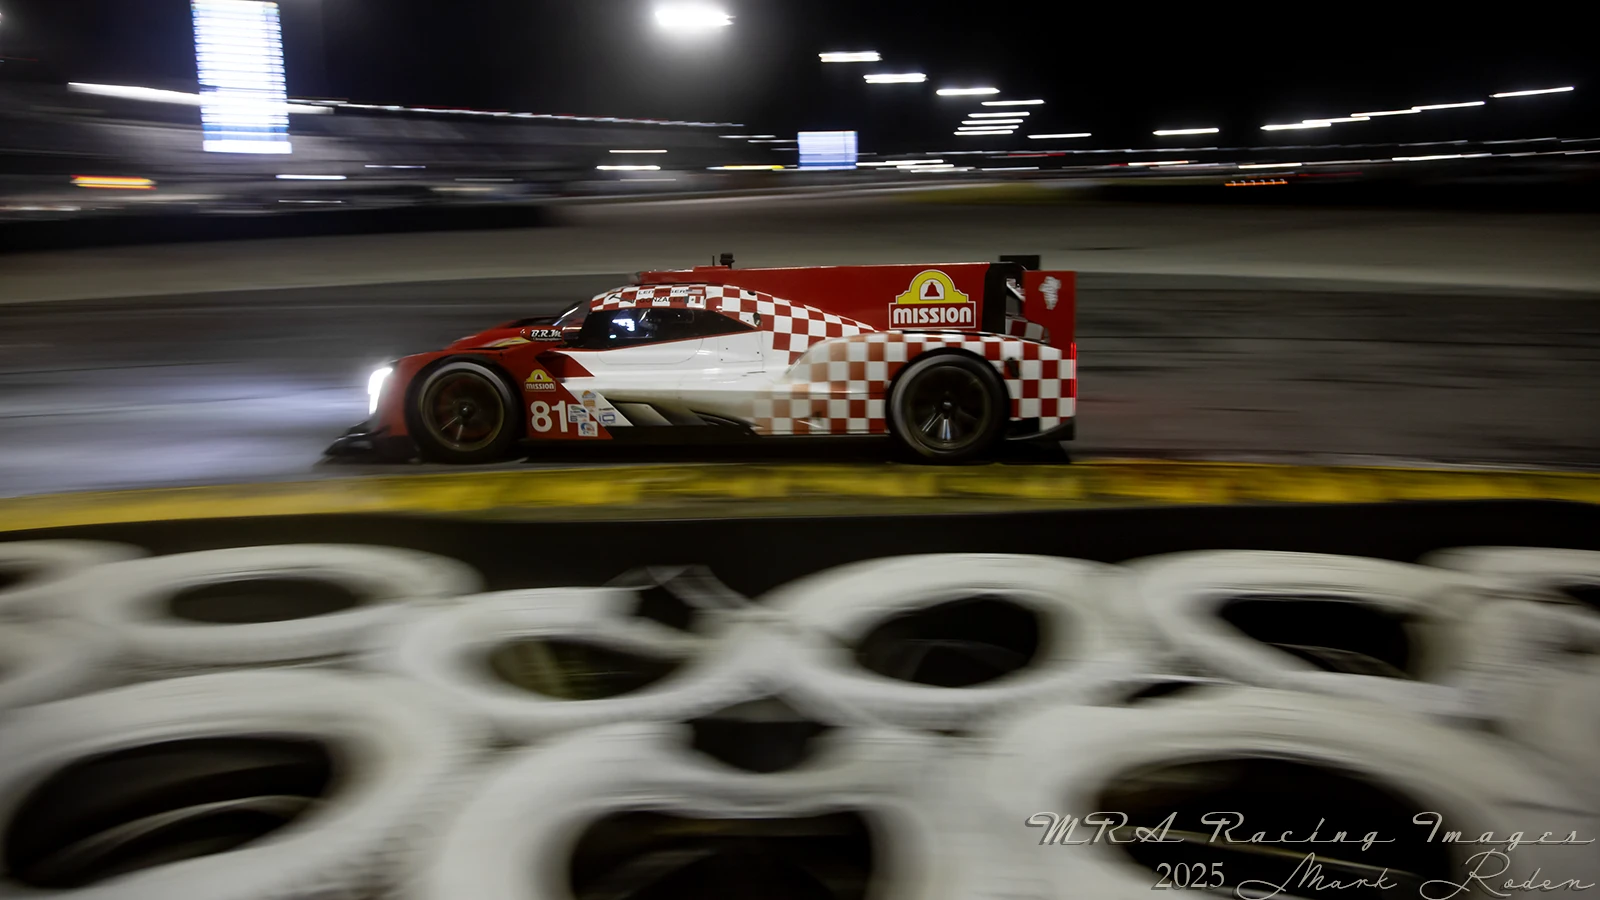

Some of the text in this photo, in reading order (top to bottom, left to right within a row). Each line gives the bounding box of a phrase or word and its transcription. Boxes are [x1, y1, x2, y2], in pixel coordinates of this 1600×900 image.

[893, 307, 972, 324] MISSION
[525, 382, 555, 390] MISSION
[530, 401, 568, 433] 81
